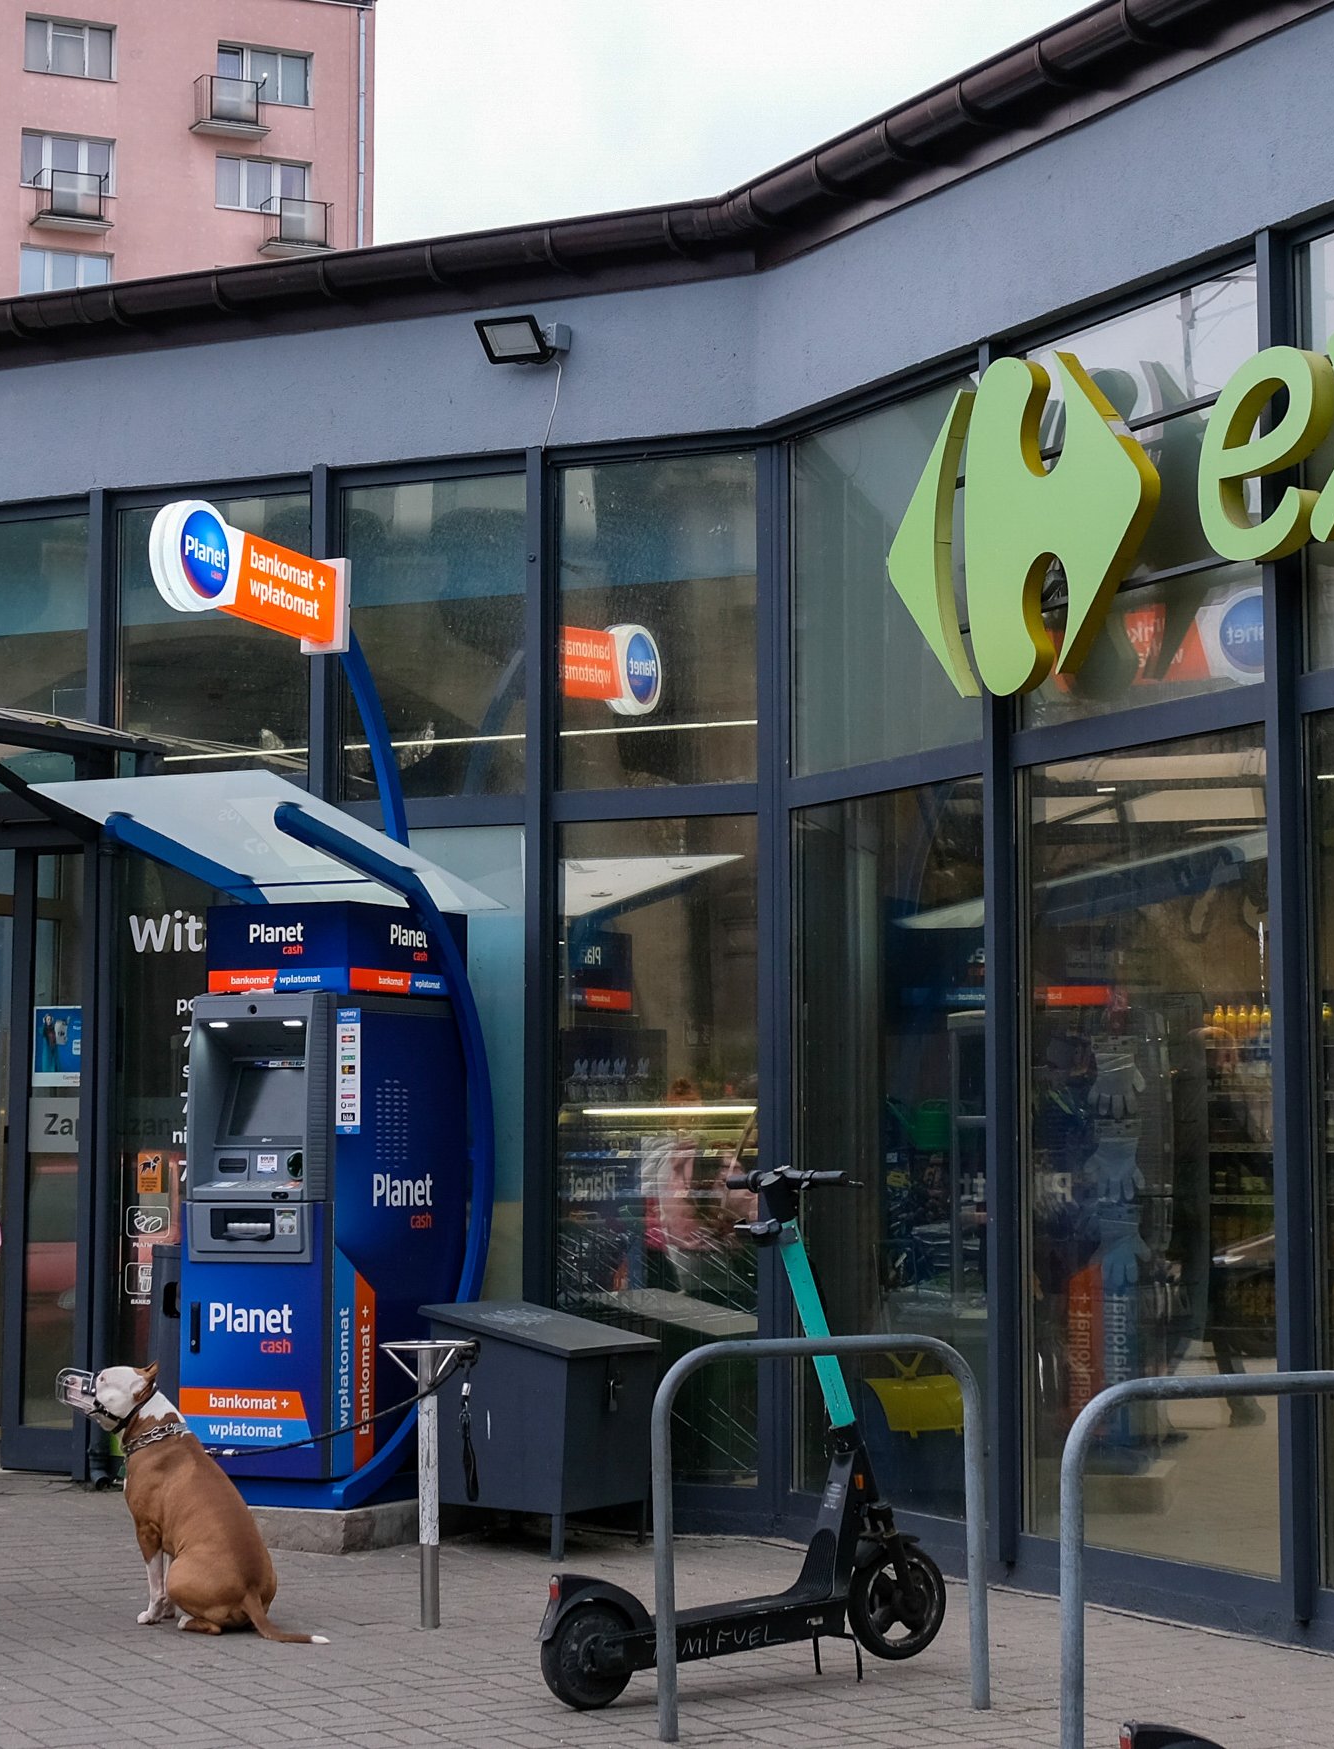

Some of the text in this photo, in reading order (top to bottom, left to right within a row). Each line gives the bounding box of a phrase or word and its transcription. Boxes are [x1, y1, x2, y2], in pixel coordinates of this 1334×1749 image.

[185, 533, 227, 572] Planet
[250, 545, 314, 591] bankomat
[129, 910, 207, 953] Wit
[249, 923, 304, 944] Planet
[282, 945, 303, 955] cash
[413, 951, 428, 962] cash
[230, 975, 270, 985] bankomat
[378, 975, 404, 986] bankomat
[373, 1173, 434, 1207] Planet
[410, 1213, 432, 1229] cash
[209, 1303, 292, 1334] Planet
[260, 1339, 291, 1354] cash
[359, 1324, 370, 1436] bankomat
[209, 1394, 277, 1411] bankomat
[209, 1421, 283, 1439] wpłatomat
